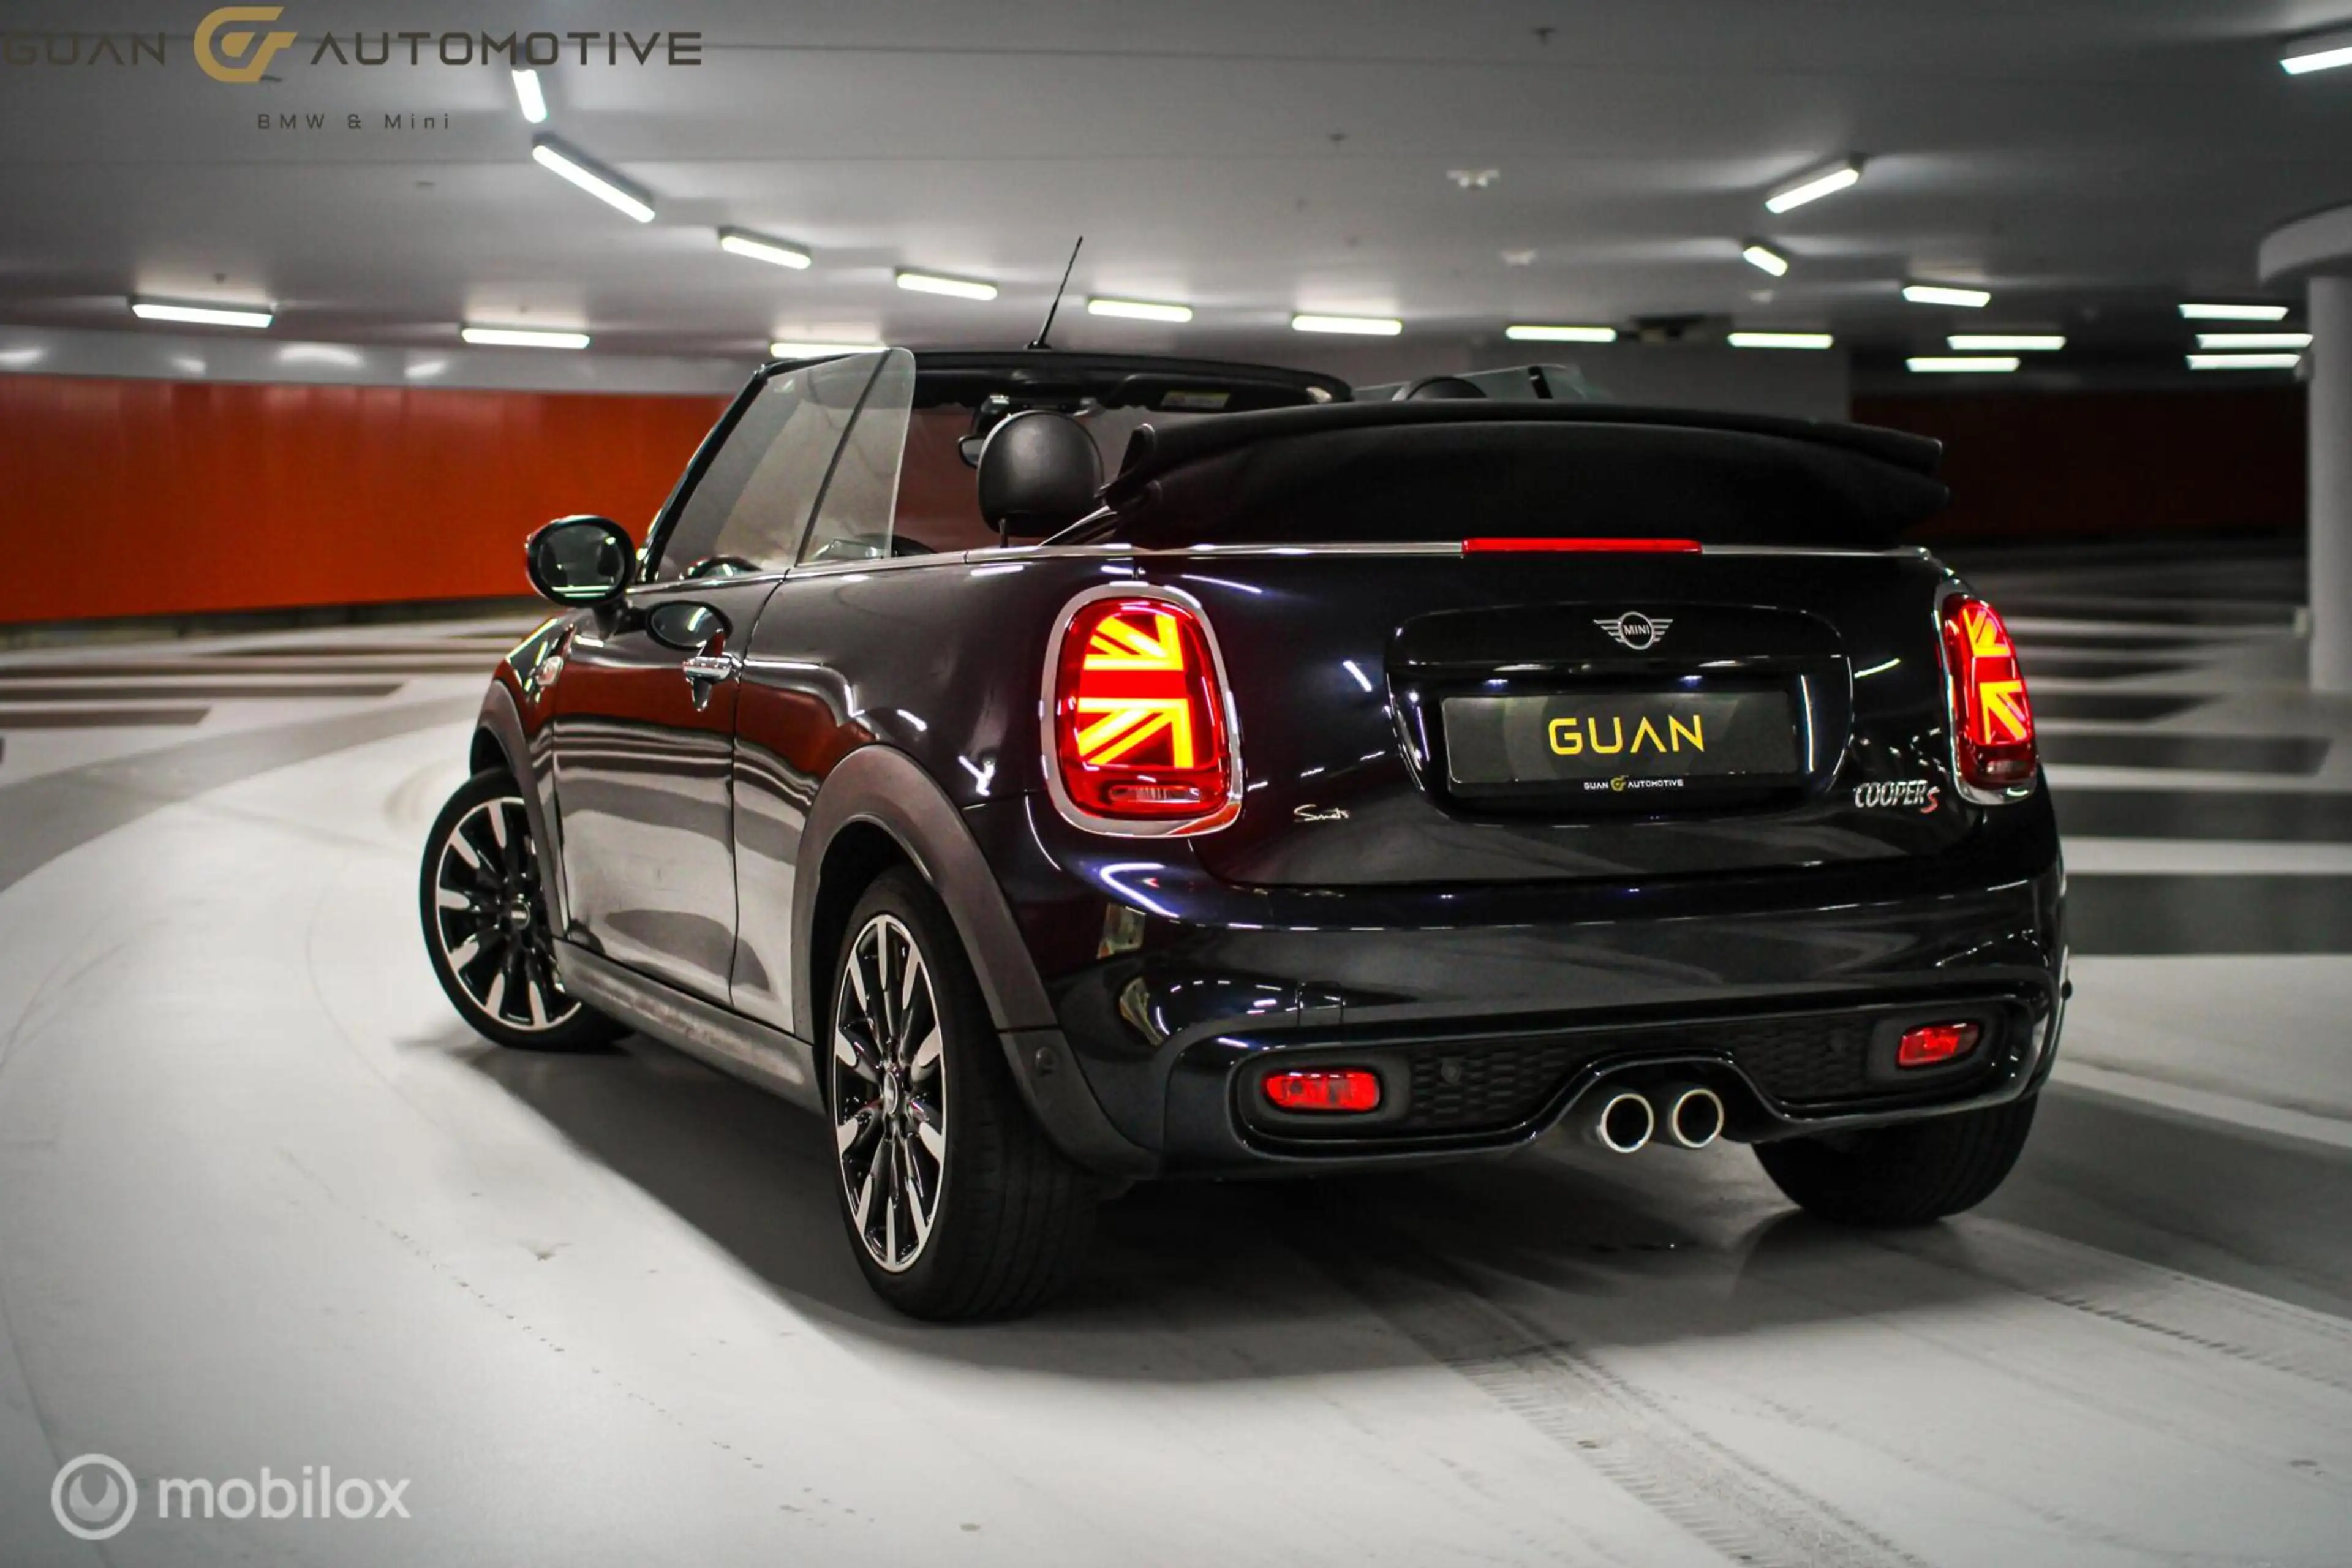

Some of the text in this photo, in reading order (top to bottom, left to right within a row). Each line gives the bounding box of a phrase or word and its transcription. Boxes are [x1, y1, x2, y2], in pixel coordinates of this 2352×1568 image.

[1623, 624, 1650, 635] MINI
[1548, 714, 1705, 755] GUAN
[1583, 778, 1684, 790] GUAN AUTOMOTIVE
